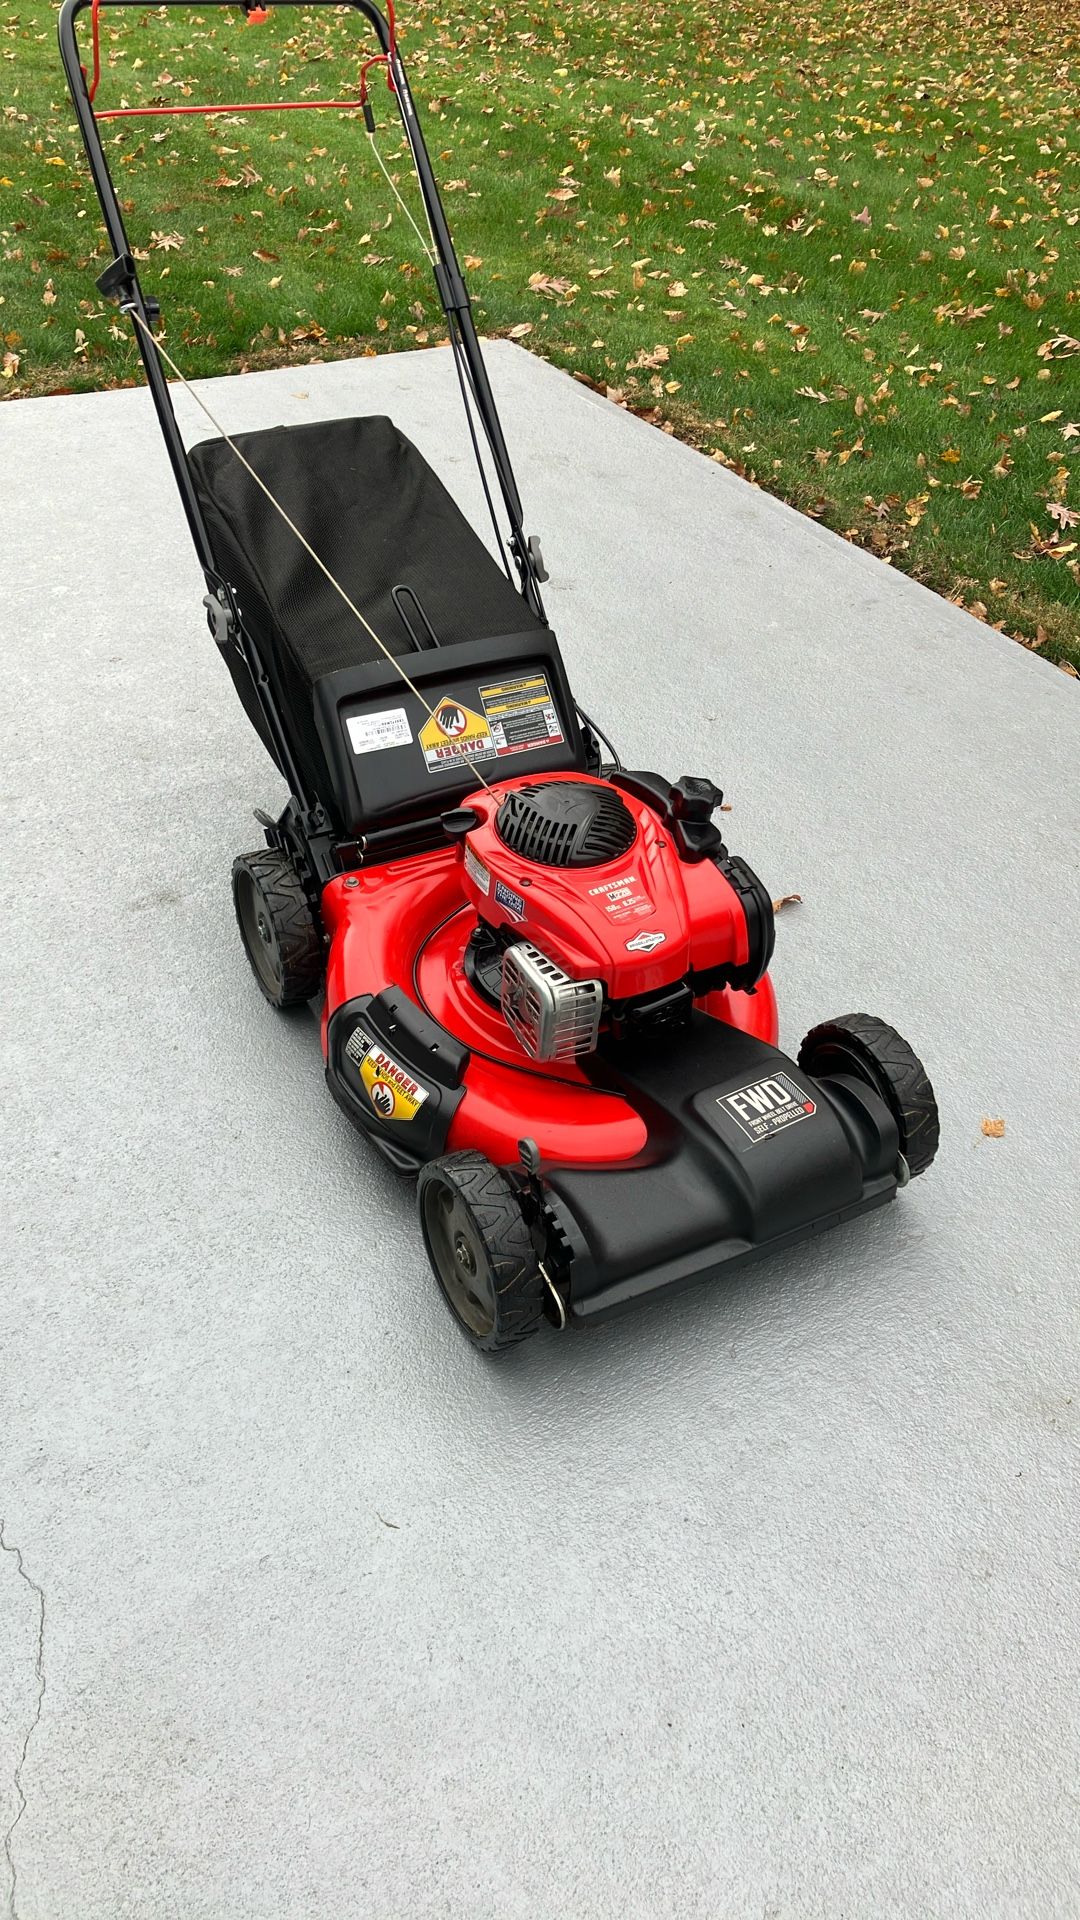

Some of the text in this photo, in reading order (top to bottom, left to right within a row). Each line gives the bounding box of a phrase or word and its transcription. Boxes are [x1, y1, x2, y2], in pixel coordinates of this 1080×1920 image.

[436, 740, 484, 758] DANGER
[588, 876, 636, 896] CRAFTSMAN
[367, 1058, 376, 1069] KEEP
[394, 1082, 406, 1096] FEET
[404, 1092, 420, 1108] AWAY
[375, 1053, 418, 1096] DANGER
[726, 1080, 792, 1121] FWD
[748, 1101, 799, 1128] FRONT WHEEL BELT DRIVE
[754, 1122, 770, 1134] SELF
[772, 1106, 806, 1126] PROPELLED
